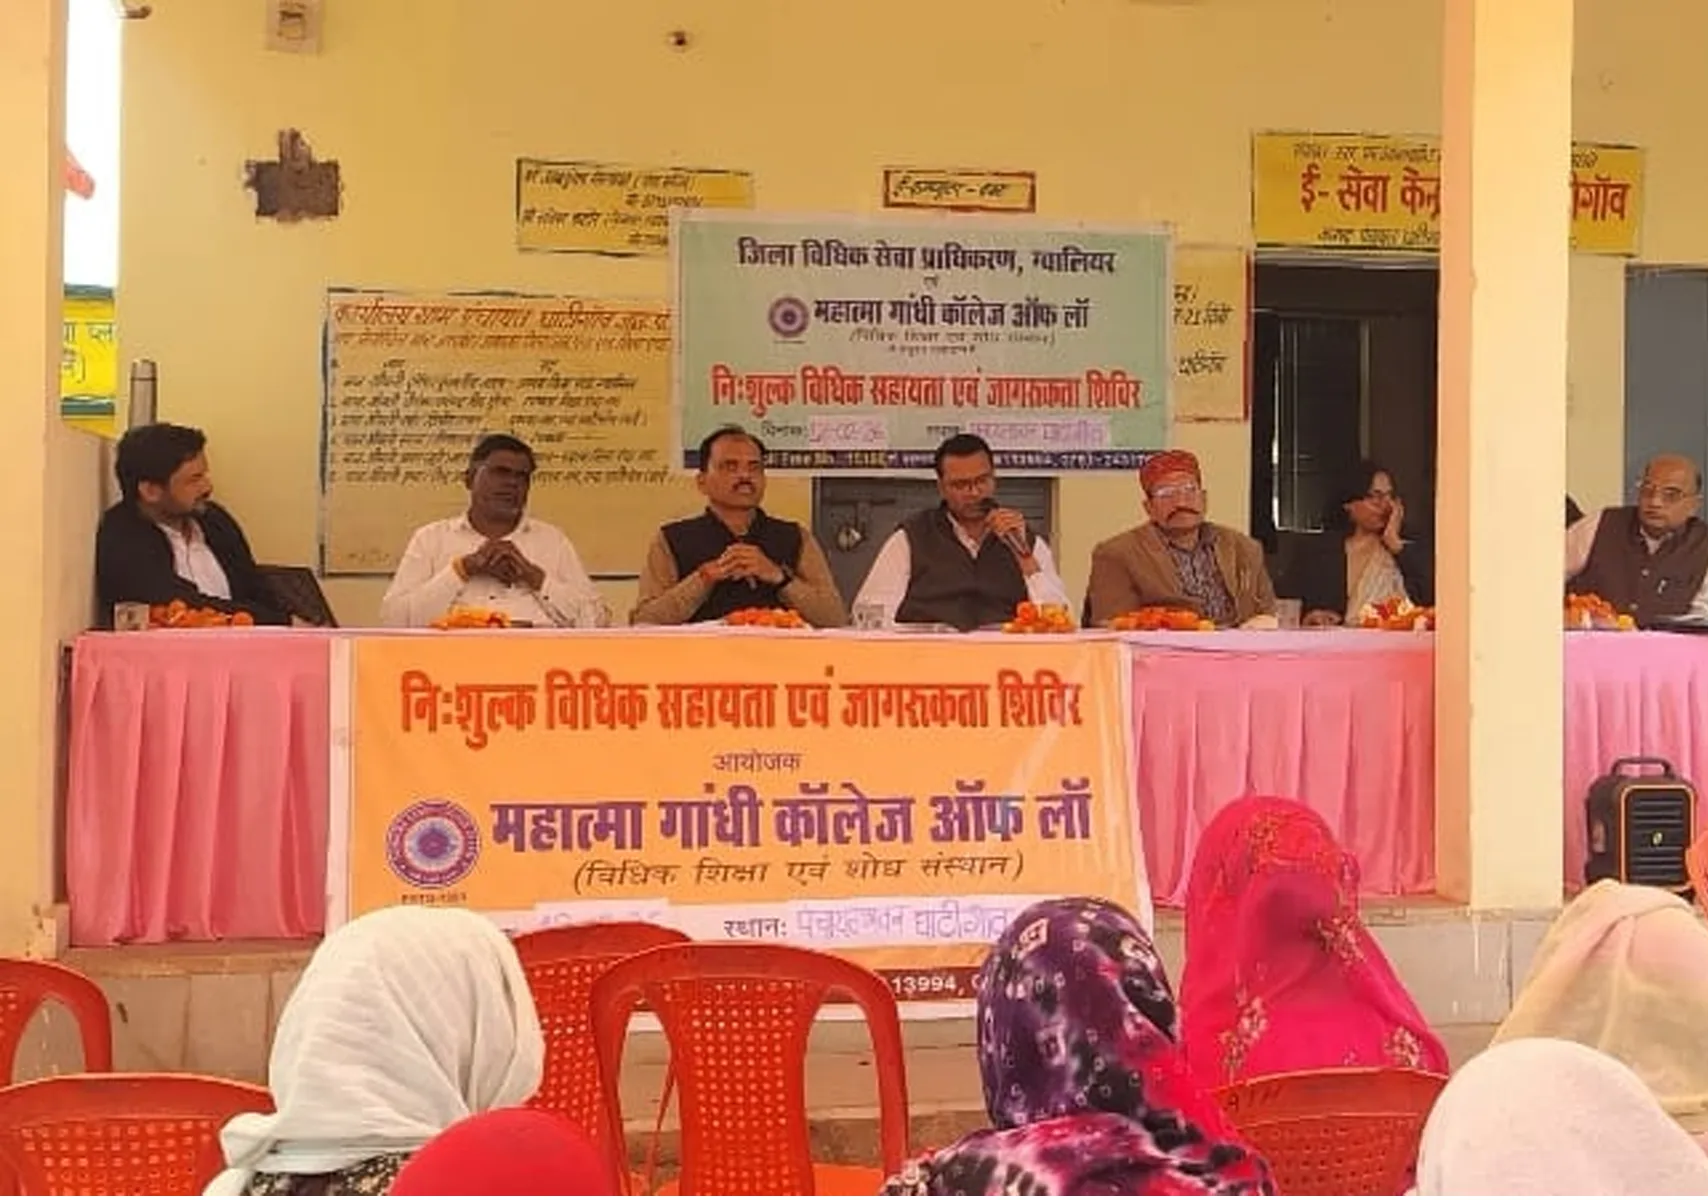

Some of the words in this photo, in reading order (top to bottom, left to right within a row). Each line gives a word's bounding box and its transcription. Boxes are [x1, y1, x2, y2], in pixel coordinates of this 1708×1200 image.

[1337, 164, 1391, 213] सेवा
[737, 236, 796, 268] जिला
[801, 238, 869, 269] विधिक
[873, 240, 917, 270] सेवा
[922, 241, 1025, 277] प्राधिकरण,
[1031, 246, 1117, 274] ग्वालियर
[814, 299, 884, 325] महात्मा
[888, 292, 937, 327] गांधी
[941, 294, 1007, 327] कॉलेज
[1011, 296, 1058, 329] ऑफ
[1062, 298, 1091, 329] लॉ
[801, 364, 866, 407] विधिक
[869, 374, 945, 408] सहायता
[949, 366, 984, 409] एवं
[1085, 369, 1143, 410] शिविर
[545, 668, 649, 731] विधिक
[657, 682, 778, 730] सहायता
[785, 665, 835, 729] एवं
[997, 667, 1084, 729] शिविर
[712, 749, 803, 773] आयोजक
[489, 801, 648, 852] महात्मा
[657, 781, 764, 850] गांधी
[772, 781, 916, 846] कॉलेज
[928, 779, 1025, 843] ऑफ
[1034, 776, 1093, 841] लॉ
[573, 858, 680, 895] (विधिक
[694, 856, 769, 885] शिक्षा
[786, 853, 832, 887] एवं
[845, 851, 907, 881] शोध
[919, 850, 1026, 882] संस्थान)
[890, 976, 965, 997] 13994,
